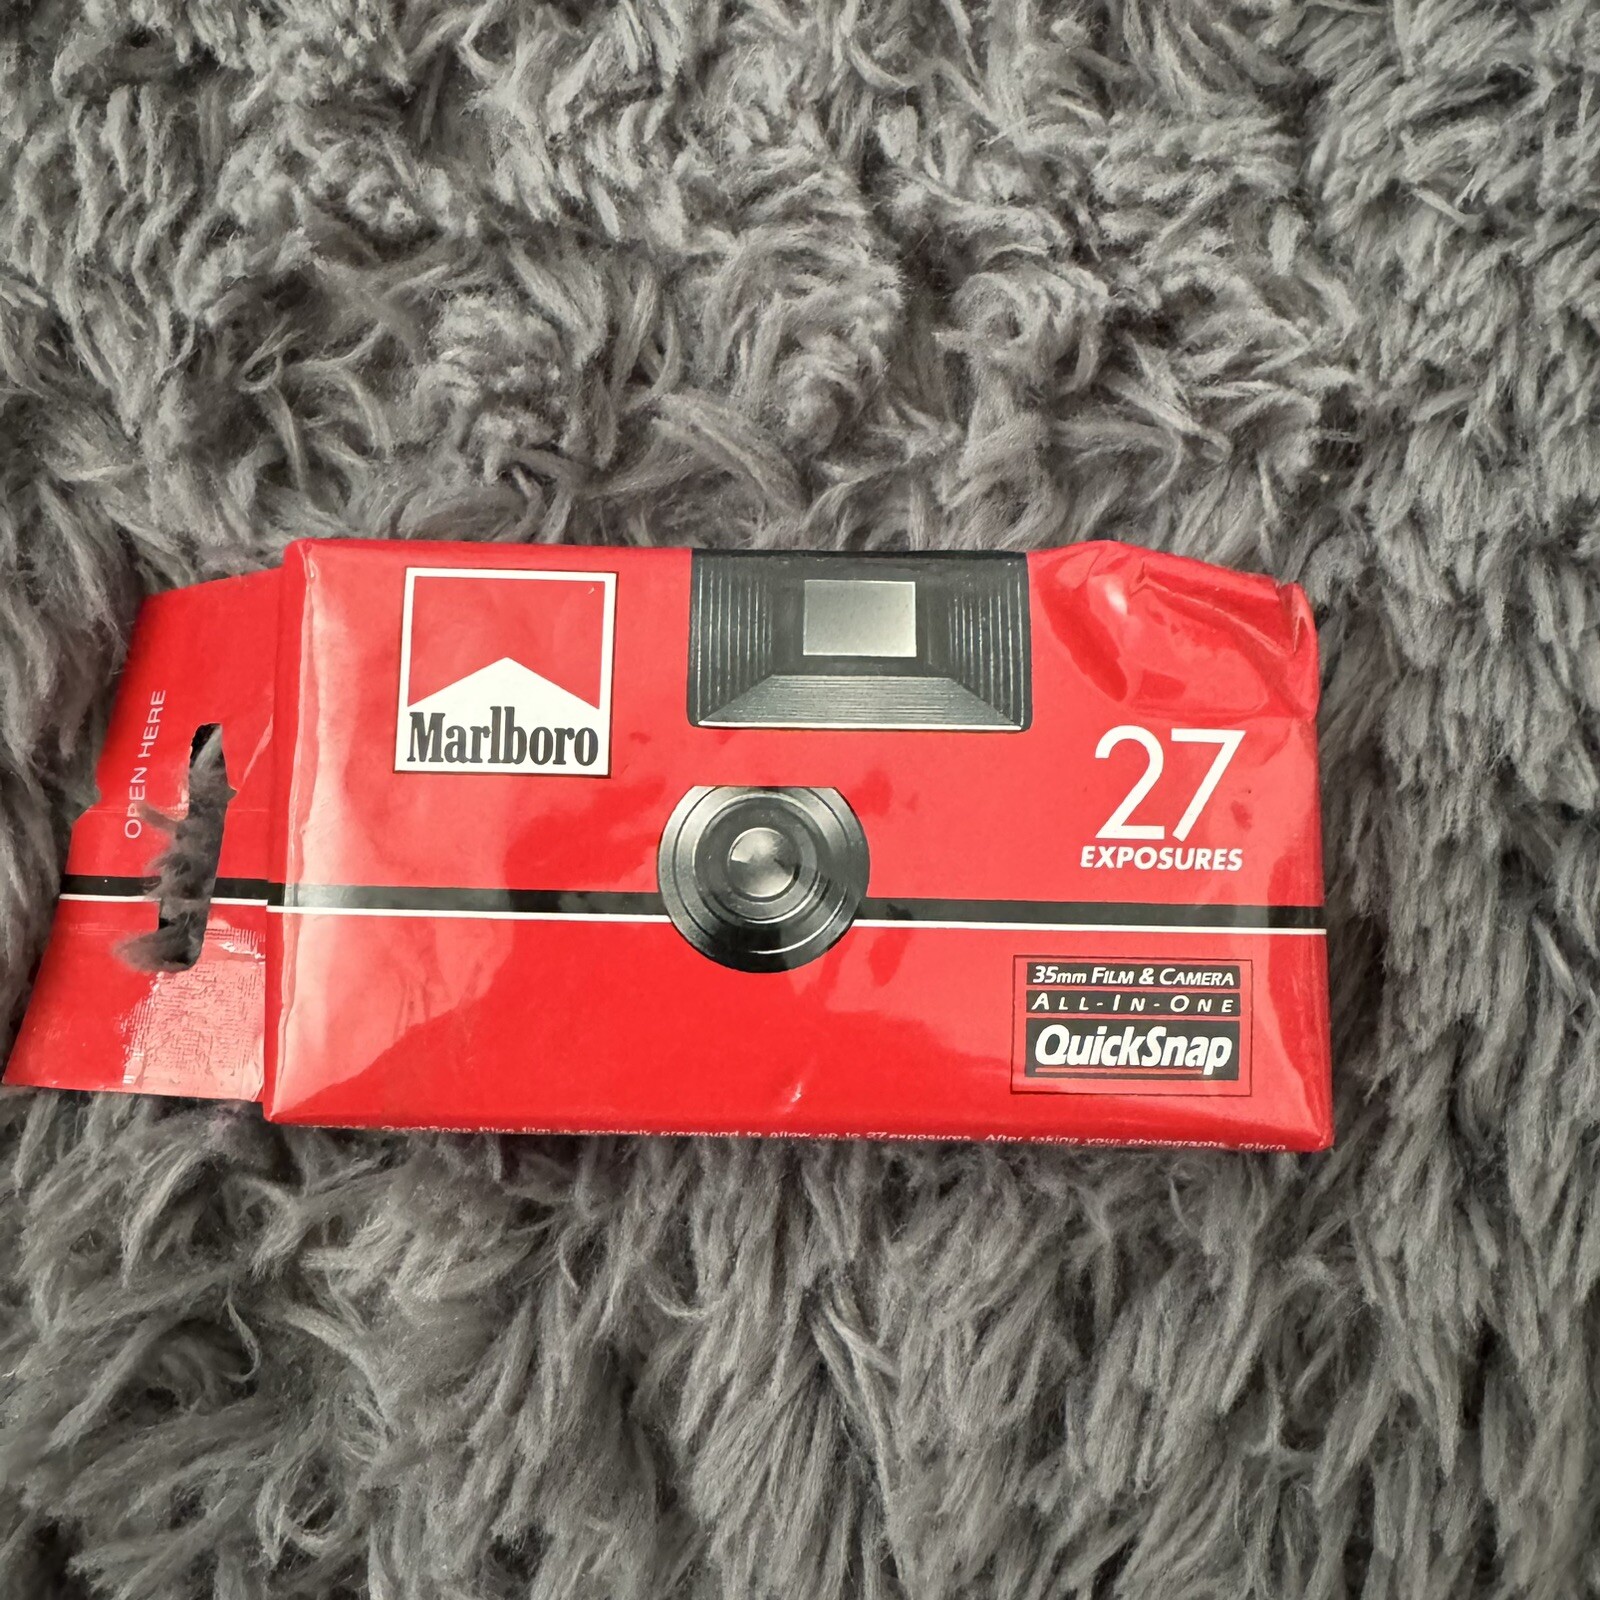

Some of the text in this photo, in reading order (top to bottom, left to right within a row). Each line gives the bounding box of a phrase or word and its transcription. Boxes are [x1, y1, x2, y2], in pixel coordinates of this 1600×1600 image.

[406, 705, 599, 766] Marlboro
[124, 689, 166, 839] OPEN HERE
[1095, 725, 1247, 842] 27
[1080, 845, 1243, 871] EXPOSURES
[1033, 965, 1235, 986] 35mm FILM & CAMERA
[1035, 1024, 1233, 1076] QuickSnap
